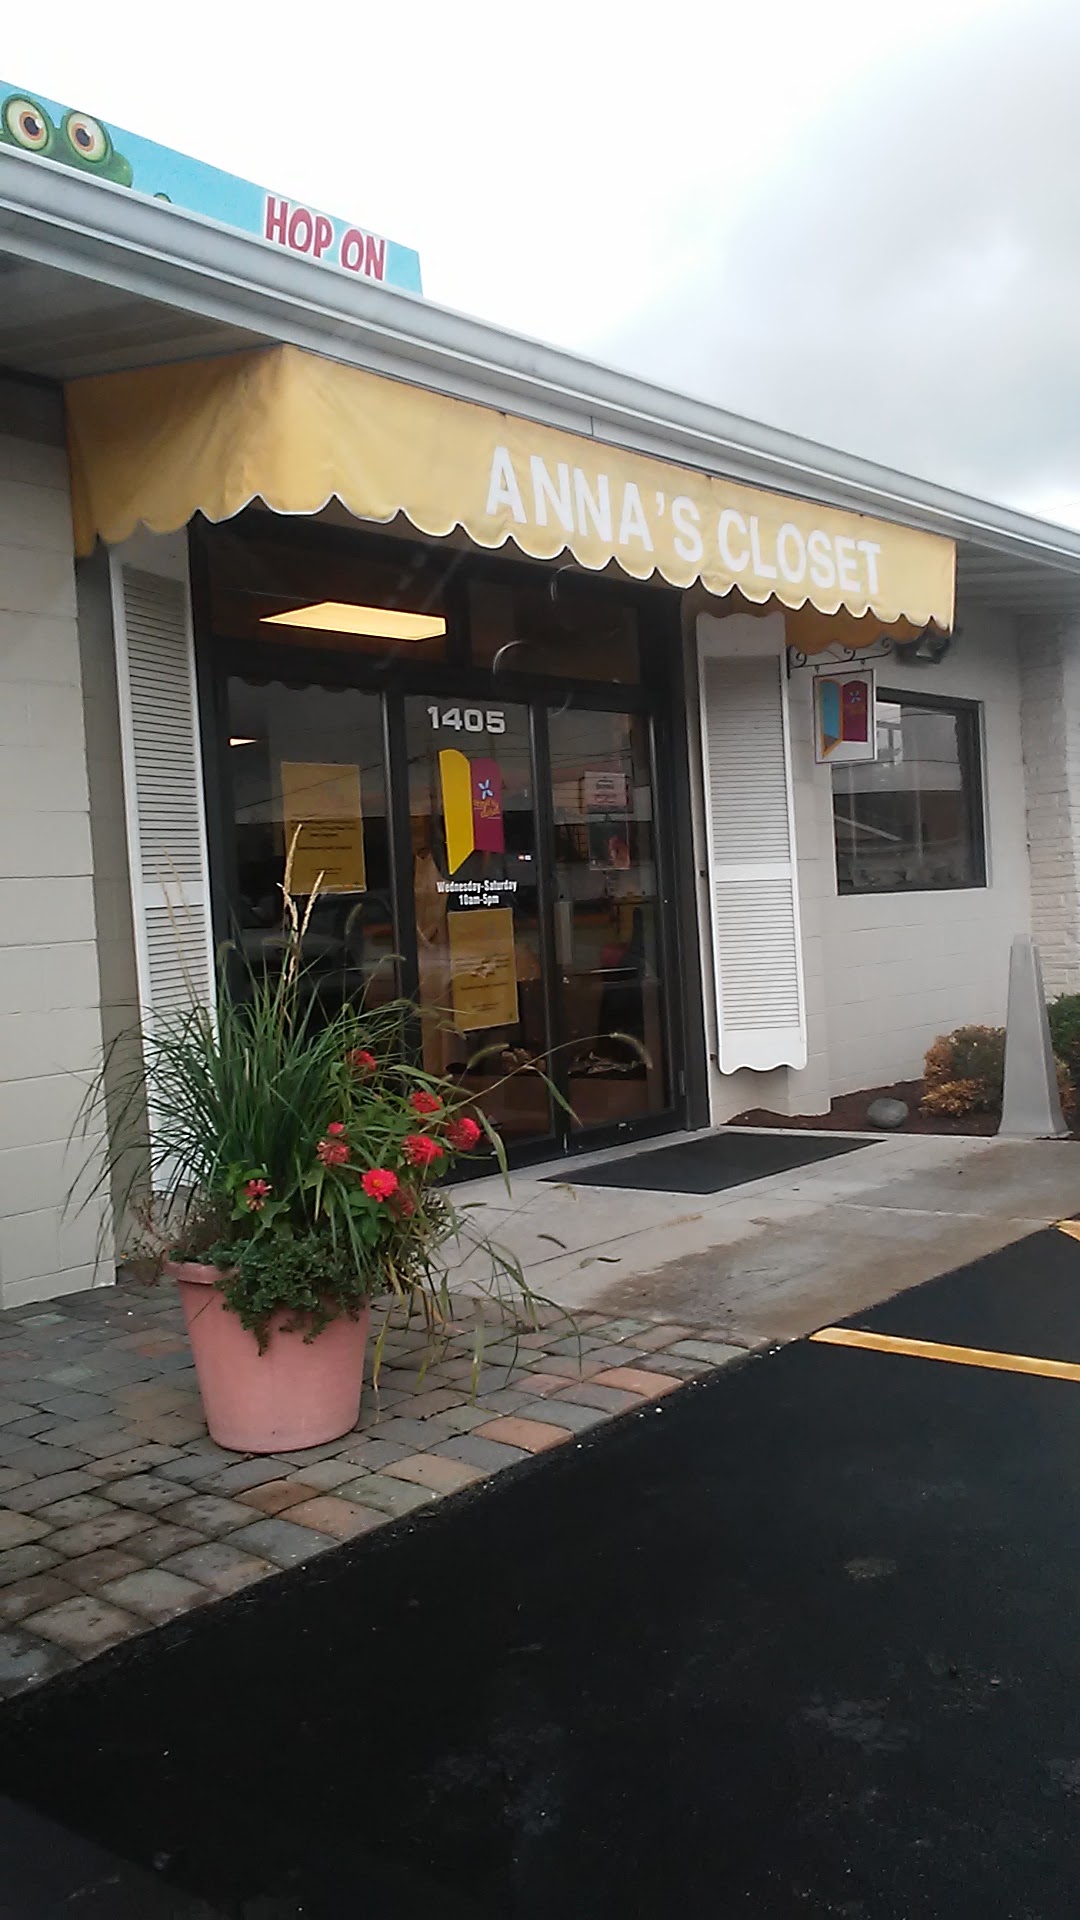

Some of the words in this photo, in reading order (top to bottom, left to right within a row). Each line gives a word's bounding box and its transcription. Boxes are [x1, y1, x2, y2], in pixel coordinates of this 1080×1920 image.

[265, 195, 333, 259] HOP
[341, 229, 386, 281] ON
[486, 445, 703, 563] ANNA'S
[717, 508, 881, 595] CLOSET
[427, 706, 506, 734] 1405
[436, 880, 518, 893] Wednesday-Saturday
[458, 893, 500, 906] 10am-5pm
